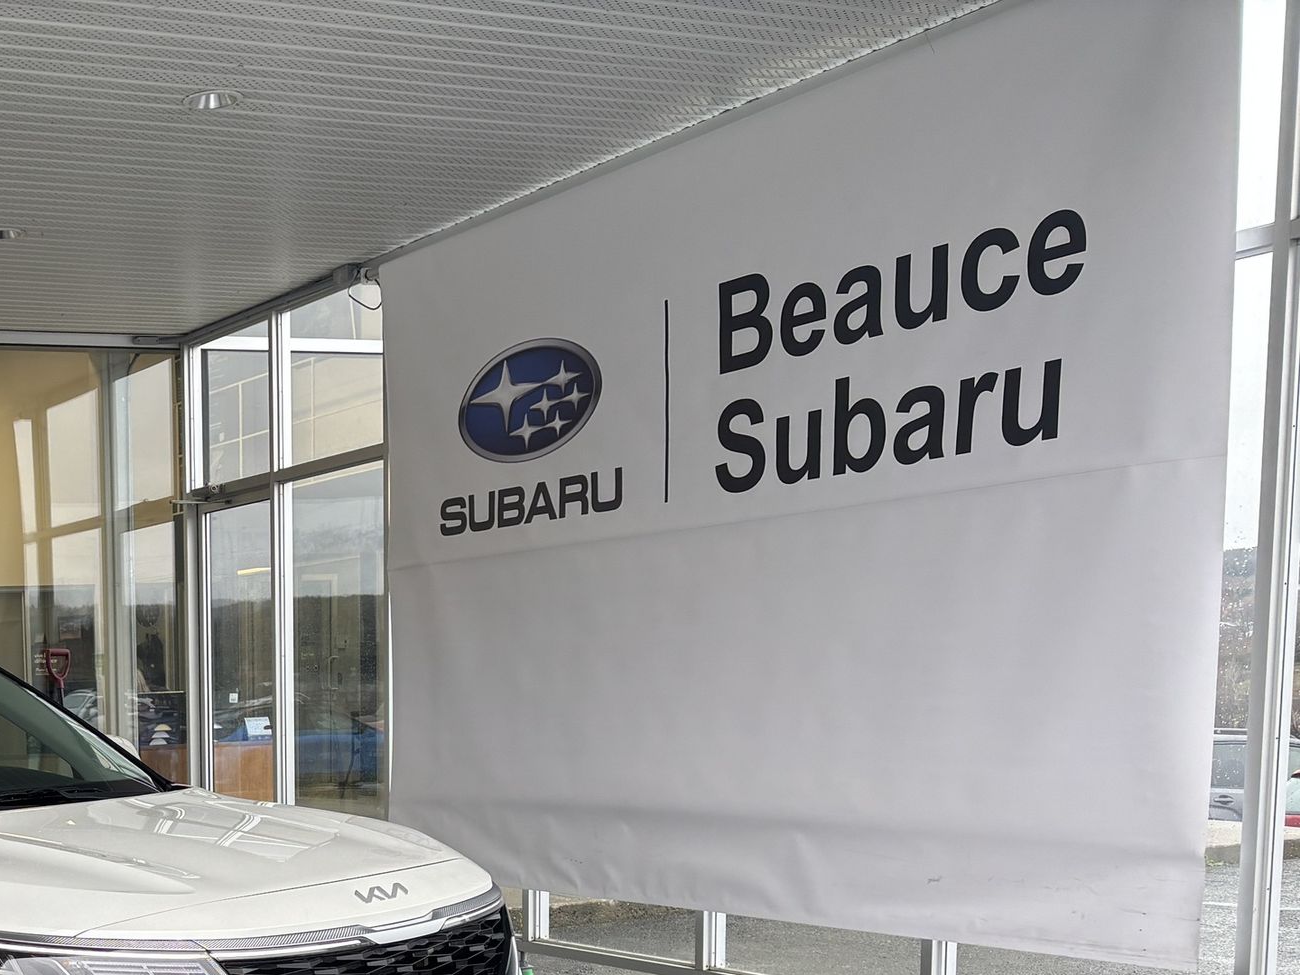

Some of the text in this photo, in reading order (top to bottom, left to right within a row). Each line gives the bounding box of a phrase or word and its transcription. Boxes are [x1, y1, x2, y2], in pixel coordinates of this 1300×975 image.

[718, 208, 1087, 375] Beauce
[714, 358, 1063, 494] Subaru
[439, 466, 623, 536] SUBARU
[354, 882, 409, 904] KIA
